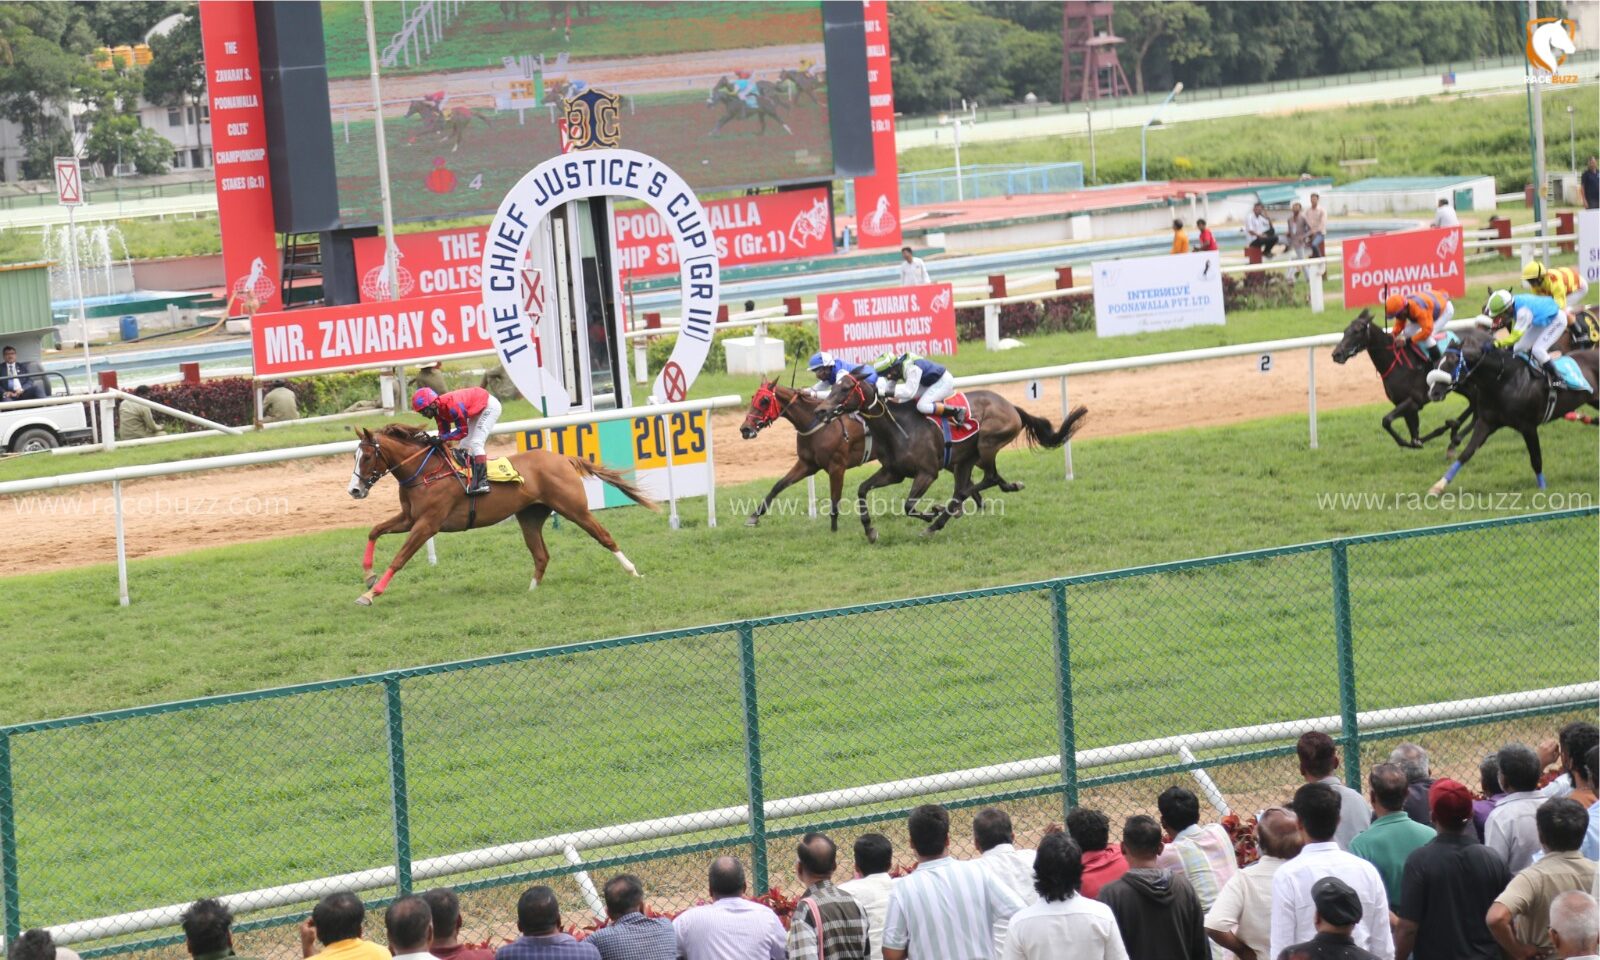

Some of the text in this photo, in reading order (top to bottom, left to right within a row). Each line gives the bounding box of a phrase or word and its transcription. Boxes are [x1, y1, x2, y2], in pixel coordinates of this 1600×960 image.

[224, 41, 238, 54] THE
[215, 68, 252, 83] ZAVARAY S.
[214, 95, 258, 110] POONAWALLA
[227, 123, 249, 136] COLTS'
[216, 149, 265, 164] CHAMPIONSHIP
[221, 176, 265, 191] STAKES (Gr.1)
[468, 173, 483, 190] 4
[533, 158, 668, 207] JUSTICE'S
[666, 192, 708, 249] CUP
[438, 233, 481, 260] THE
[490, 203, 529, 292] CHIEF
[734, 230, 786, 259] (Gr.1)
[1351, 260, 1458, 288] POONAWALLA
[852, 294, 920, 317] THE ZAVARAY S.
[1108, 300, 1169, 314] POONAWALLA
[264, 325, 313, 365] MR.
[319, 311, 424, 359] ZAVARAY
[431, 308, 455, 345] S.
[493, 303, 529, 364] THE
[843, 316, 933, 341] POONAWALLA COLTS'
[895, 340, 927, 357] STAKES
[1260, 355, 1270, 371] 2
[1031, 382, 1038, 399] 1
[635, 410, 706, 460] 2025
